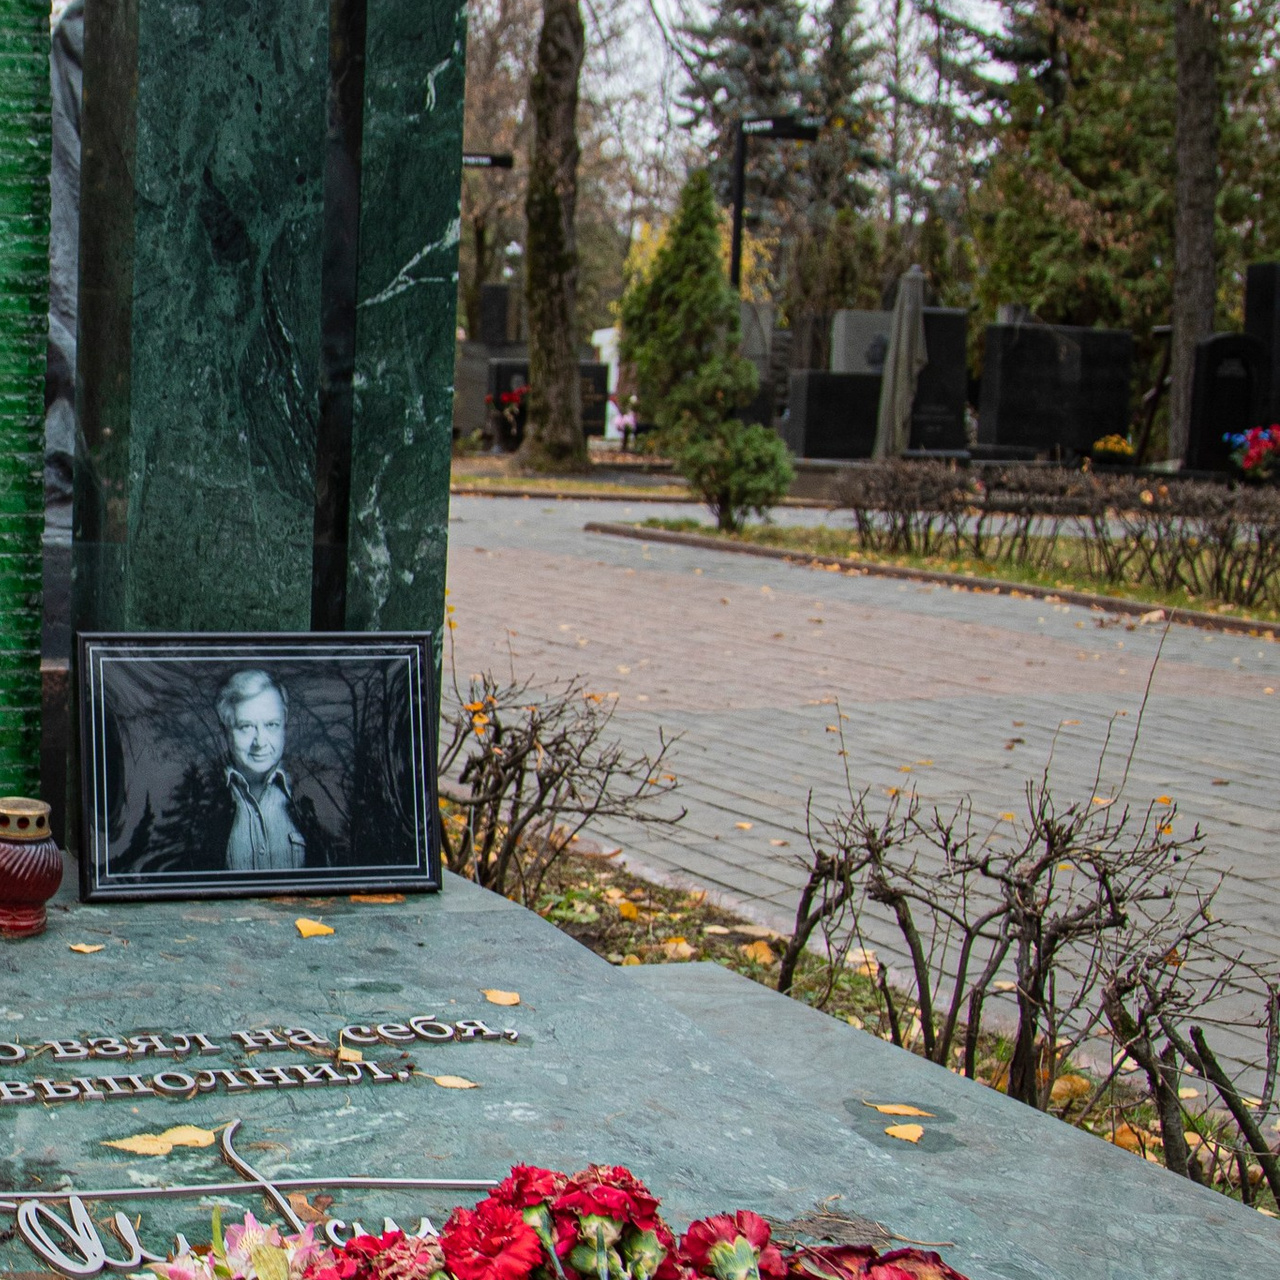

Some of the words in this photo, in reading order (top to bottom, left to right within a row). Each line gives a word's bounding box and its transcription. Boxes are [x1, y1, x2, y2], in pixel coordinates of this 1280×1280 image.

[45, 1030, 220, 1062] взял
[231, 1027, 332, 1052] на
[342, 1014, 520, 1045] себя,
